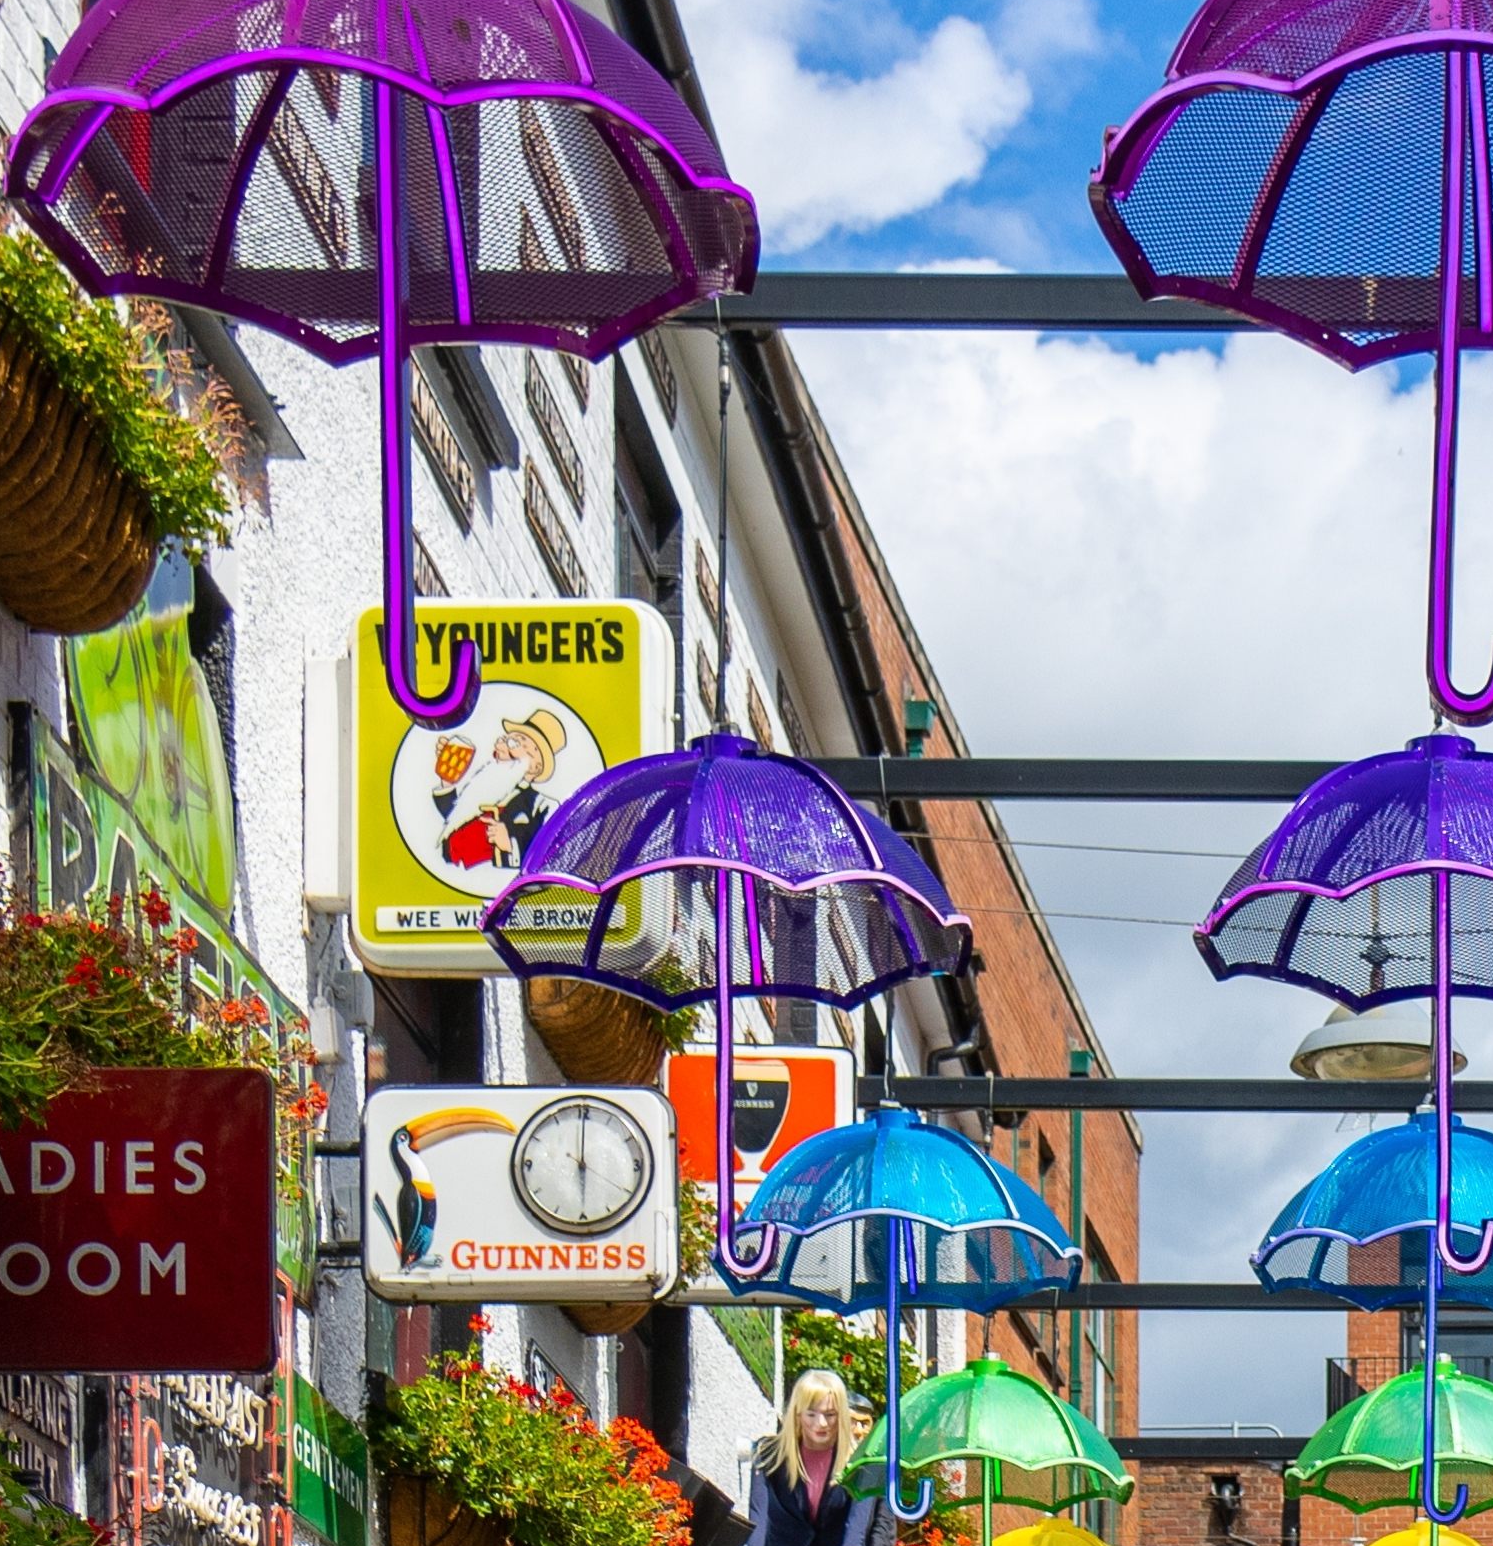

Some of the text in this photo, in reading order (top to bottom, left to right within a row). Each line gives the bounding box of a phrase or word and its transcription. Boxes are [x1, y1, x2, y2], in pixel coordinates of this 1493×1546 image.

[397, 910, 441, 929] WEE
[524, 1159, 533, 1173] 9
[633, 1158, 642, 1173] 3
[450, 1239, 647, 1271] GUINNESS
[292, 1422, 364, 1515] GENTLEMEN
